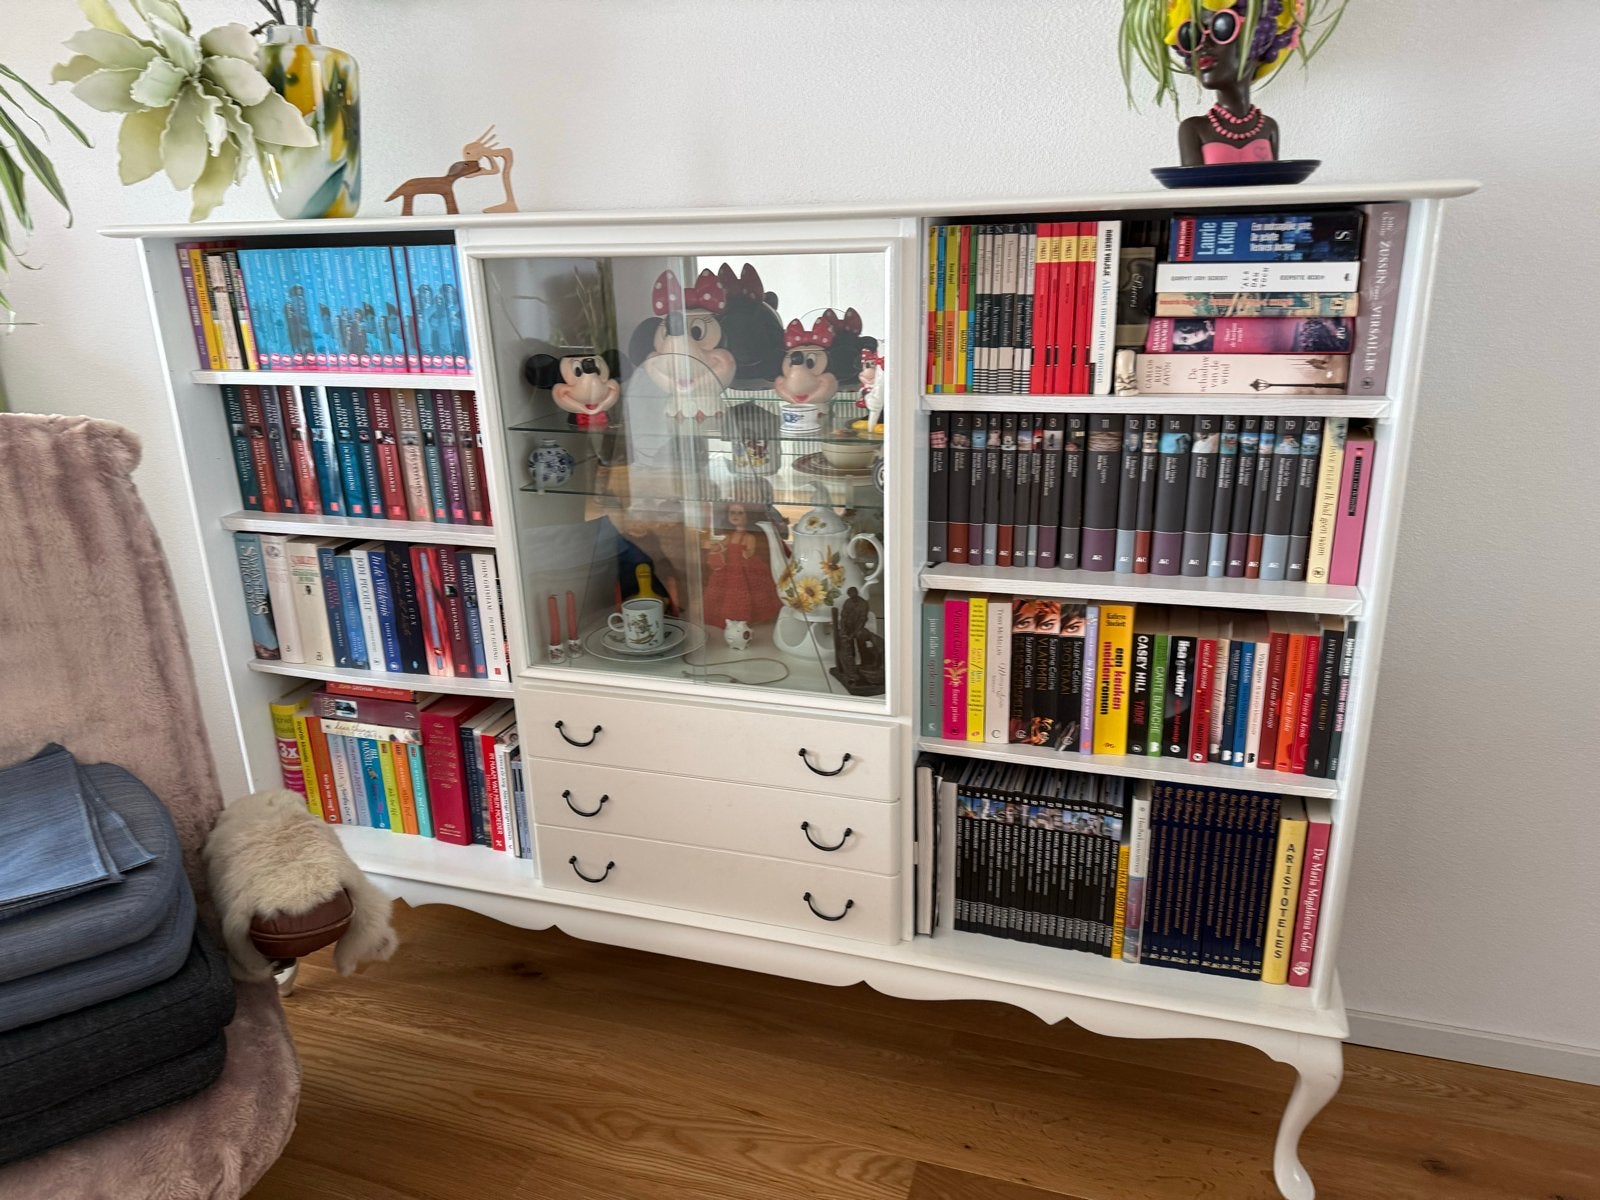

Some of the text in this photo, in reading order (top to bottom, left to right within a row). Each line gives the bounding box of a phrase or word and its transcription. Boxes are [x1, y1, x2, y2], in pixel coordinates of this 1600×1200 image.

[1104, 229, 1113, 252] ROBERT
[1197, 222, 1217, 255] Laurie
[1375, 240, 1392, 284] ZUSSEN
[1101, 280, 1112, 306] Alleen
[1364, 305, 1384, 371] VERSAILLES
[1221, 363, 1230, 385] wind
[372, 393, 384, 429] GRISHAM
[380, 409, 388, 429] JOHN
[397, 394, 410, 429] GRISHAM
[405, 409, 415, 429] JOHN
[417, 394, 429, 430] GRISHAM
[425, 410, 434, 430] JOHN
[436, 394, 448, 430] GRISHAM
[444, 410, 452, 430] JOHN
[454, 395, 466, 432] GRISHAM
[462, 411, 471, 432] JOHN
[937, 417, 941, 426] 1
[957, 418, 963, 427] 2
[975, 418, 982, 427] 3
[990, 418, 997, 427] 4
[1006, 418, 1012, 428] 5
[1021, 418, 1028, 428] 6
[1035, 418, 1042, 427] 7
[1049, 418, 1057, 428] 8
[1070, 419, 1080, 429] 10
[1102, 419, 1110, 428] 11
[1129, 420, 1139, 430] 12
[1146, 420, 1157, 429] 13
[1170, 421, 1180, 430] 14
[1201, 419, 1211, 429] 15
[1225, 421, 1236, 430] 16
[1245, 420, 1255, 429] 17
[1264, 420, 1275, 430] 18
[1285, 420, 1295, 430] 19
[1305, 420, 1319, 431] 20
[386, 456, 396, 493] RAINMAKER
[1322, 503, 1333, 516] had
[1319, 518, 1330, 534] geen
[1318, 536, 1328, 556] naam
[440, 549, 451, 582] GRISHAM
[447, 564, 455, 582] JOHN
[460, 560, 469, 593] GRISHAM
[480, 560, 488, 579] JOHN
[355, 557, 372, 612] JODI PICOULT
[371, 556, 390, 617] In de Wildernis
[402, 563, 417, 626] MICHAEL COX
[483, 579, 492, 610] GRISHAM
[451, 607, 460, 640] GEVANGENE
[471, 618, 480, 645] PARTNER
[928, 618, 940, 657] jane fallon
[1072, 641, 1080, 669] Suzanne
[1135, 635, 1149, 669] CASEY
[1177, 641, 1190, 659] lisa
[1325, 638, 1337, 665] ESTHER
[1024, 636, 1033, 688] Suzanne Collins
[1036, 638, 1048, 691] VLAMMEN
[1048, 638, 1057, 690] Suzanne Collins
[1060, 642, 1070, 695] SPOTGAAI
[1100, 641, 1114, 715] meidenroman
[1113, 648, 1126, 710] een keuken
[1134, 672, 1146, 693] HILL
[1174, 660, 1188, 697] gardner
[1322, 666, 1334, 696] VERHOEF
[1151, 666, 1164, 734] CARTE BLANCHE
[950, 706, 960, 722] prins
[362, 741, 372, 766] MANSELL
[370, 748, 378, 759] JILL
[488, 752, 494, 760] IN
[488, 760, 496, 780] NAAM
[494, 809, 503, 835] MOEDER
[1274, 843, 1296, 959] ARISTOTELES
[1299, 848, 1324, 953] De Maria Magdalena Code
